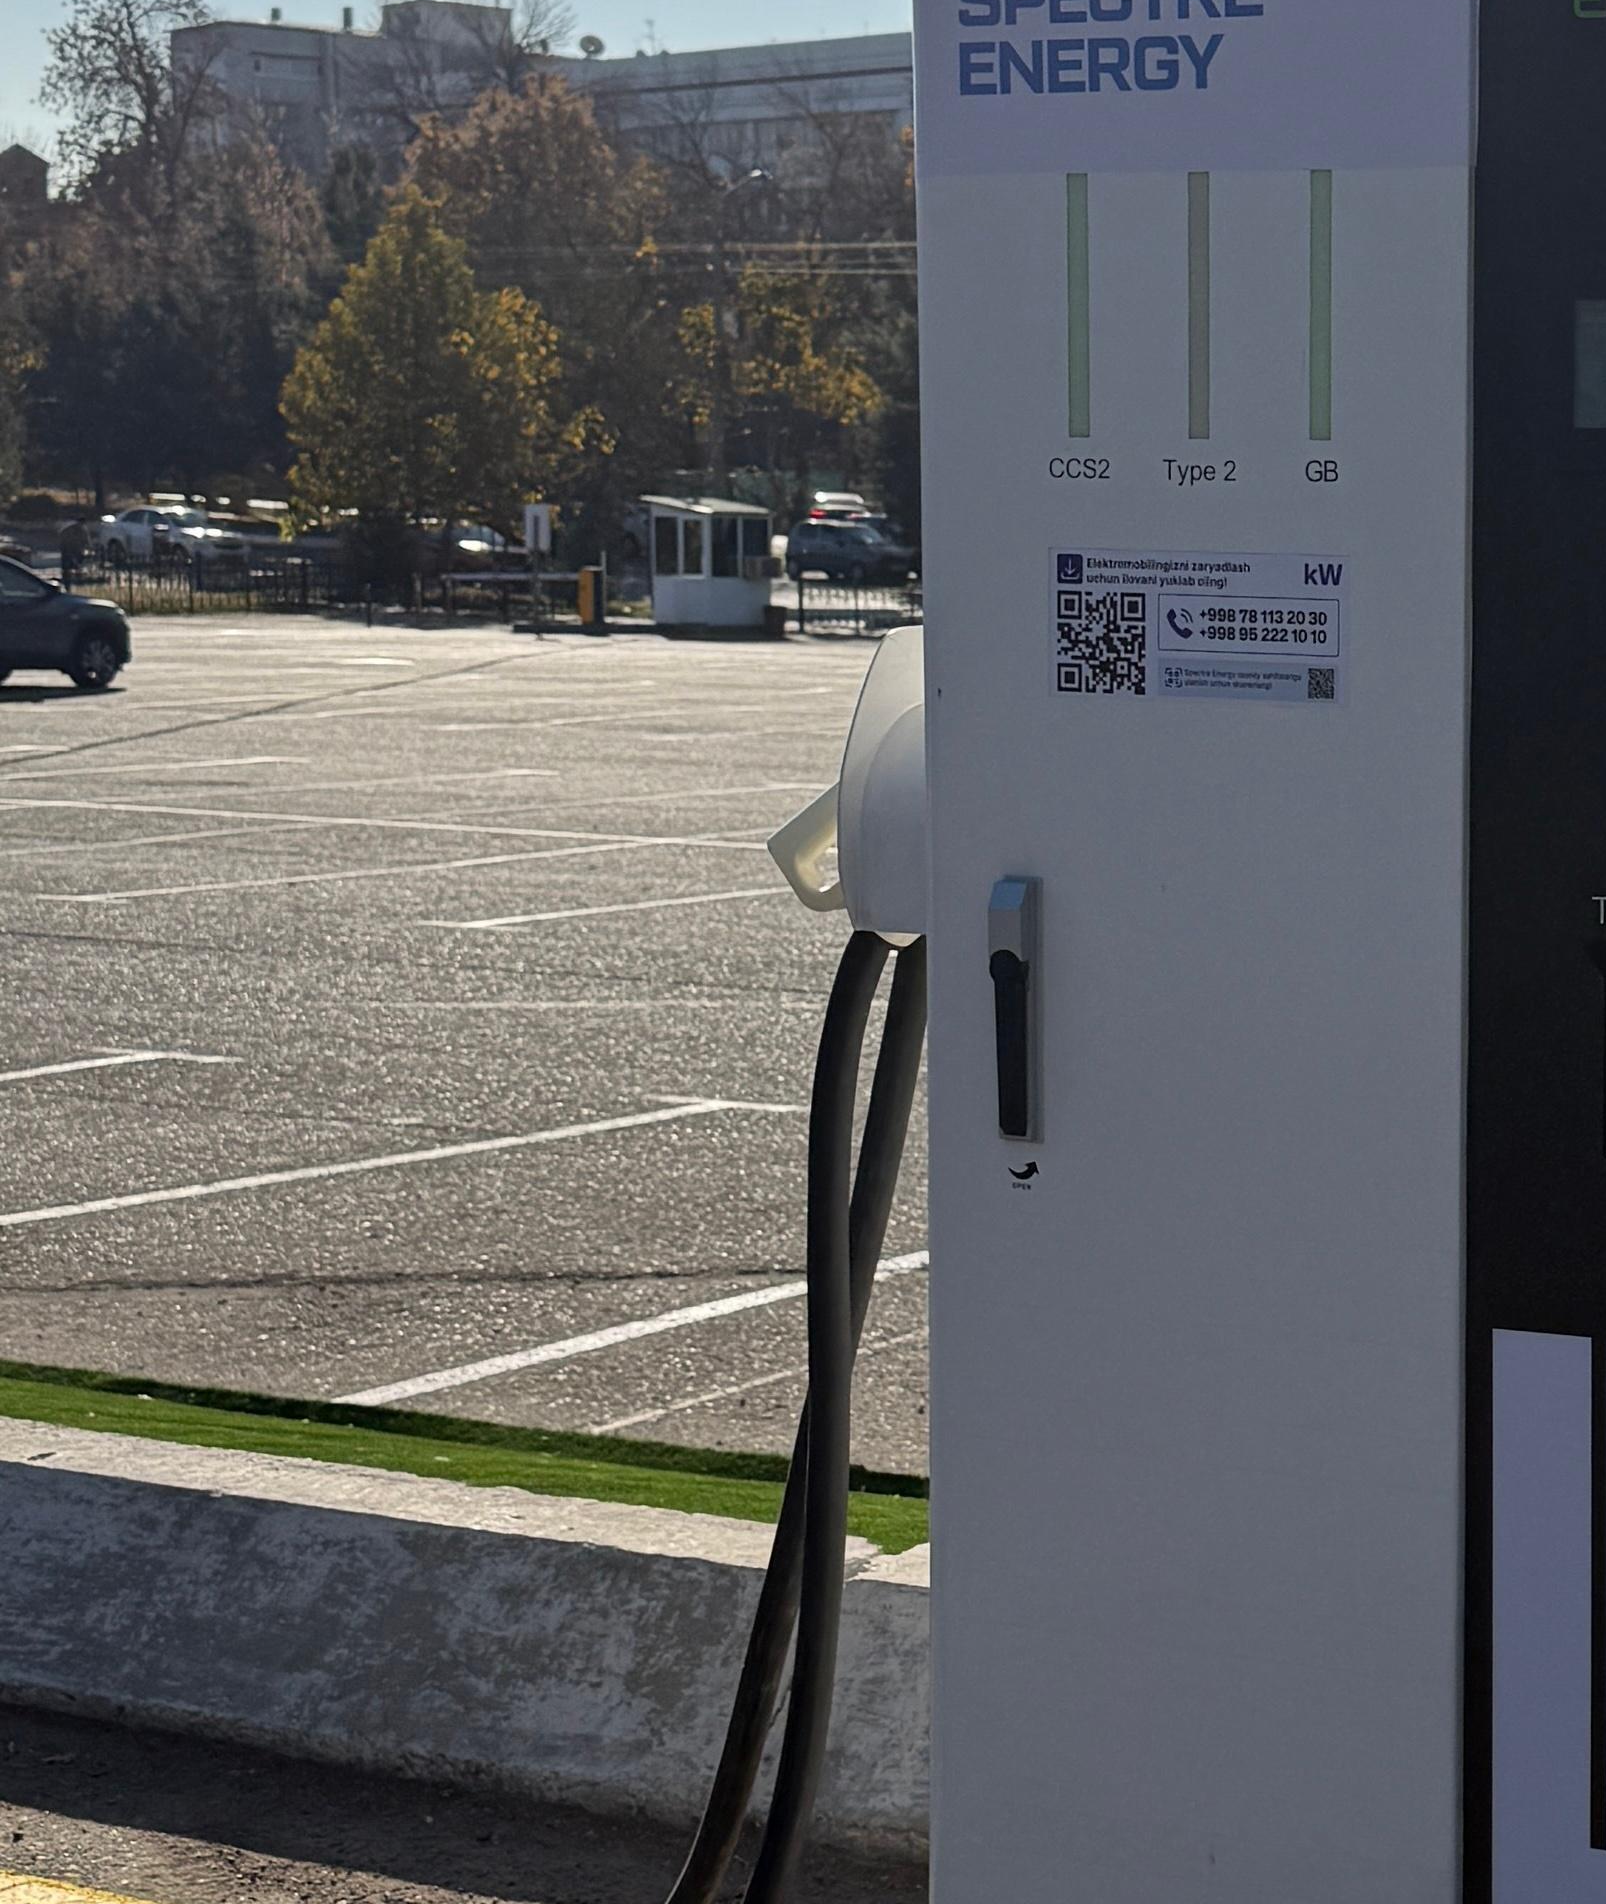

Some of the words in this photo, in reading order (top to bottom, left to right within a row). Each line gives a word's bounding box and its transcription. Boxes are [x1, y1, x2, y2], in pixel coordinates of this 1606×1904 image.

[958, 33, 1225, 96] ENERGY
[1049, 457, 1111, 481] CCS2
[1162, 458, 1216, 487] Type
[1223, 459, 1237, 482] 2
[1305, 459, 1339, 483] GB
[1304, 563, 1343, 586] kW
[1200, 608, 1236, 623] +998
[1239, 609, 1258, 624] 78
[1260, 610, 1284, 624] 113
[1287, 610, 1306, 625] 20
[1308, 611, 1328, 626] 30
[1200, 626, 1236, 641] +998
[1239, 627, 1258, 642] 95
[1261, 628, 1289, 642] 222
[1291, 629, 1308, 643] 10
[1310, 629, 1327, 644] 10
